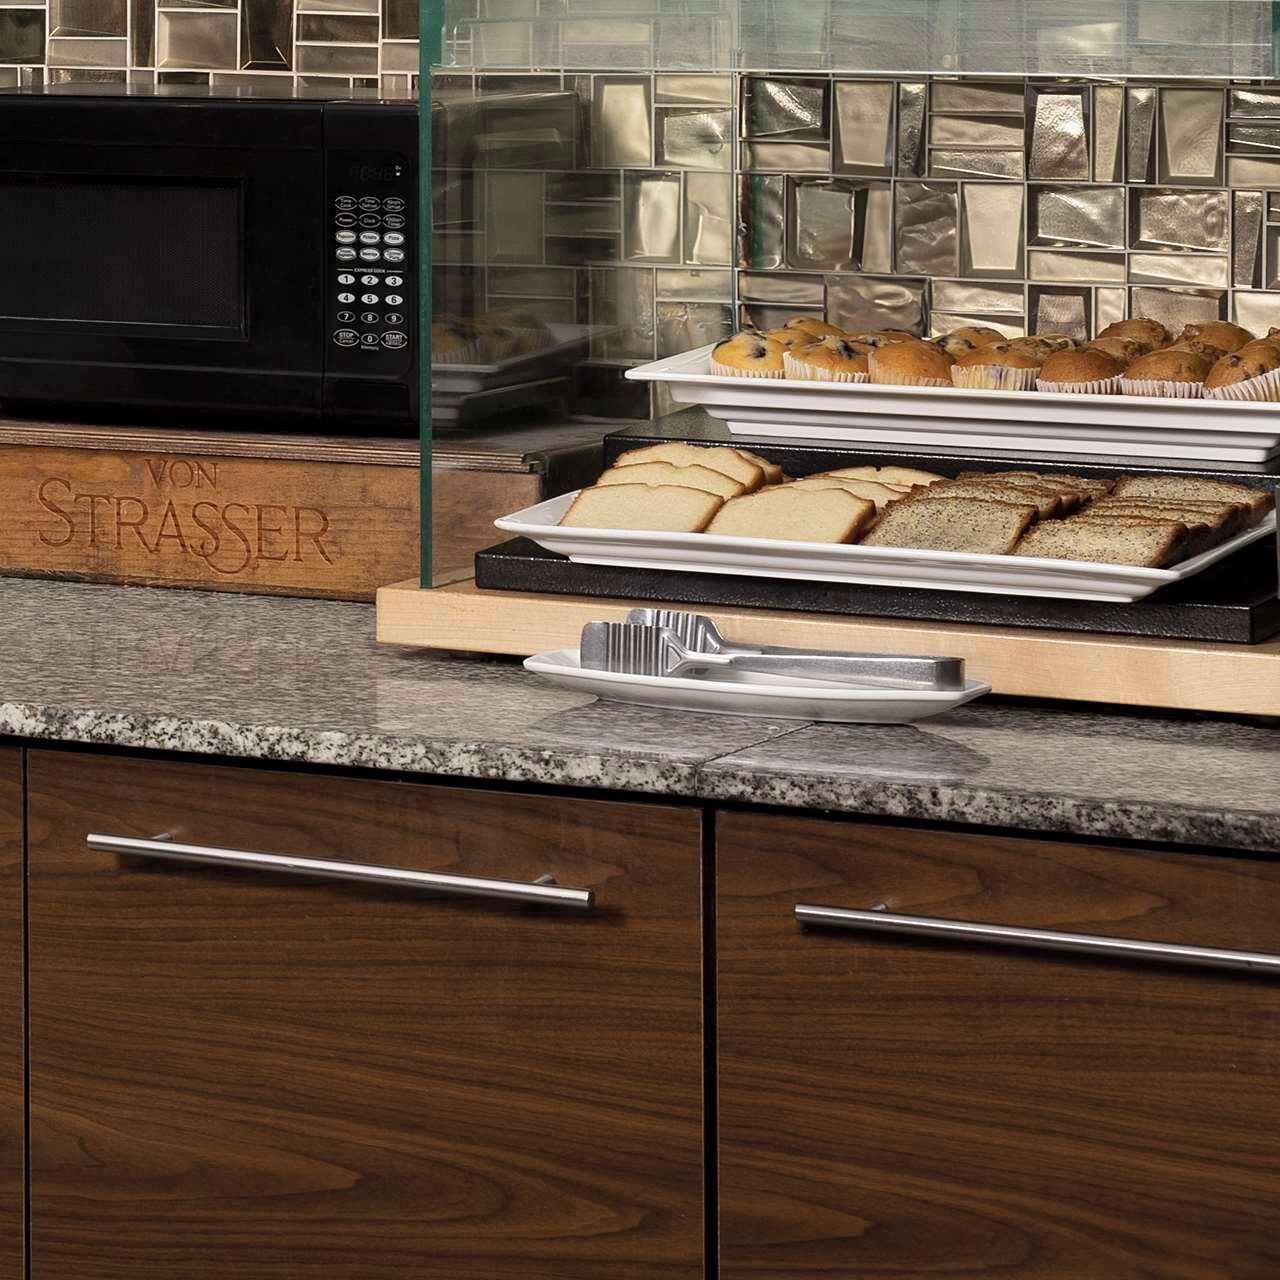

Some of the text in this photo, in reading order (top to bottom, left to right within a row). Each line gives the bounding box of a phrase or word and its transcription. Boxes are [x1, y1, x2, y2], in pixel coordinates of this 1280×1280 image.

[344, 275, 397, 285] 1 2 3
[367, 335, 373, 343] 0
[144, 459, 218, 489] VON
[38, 477, 334, 574] STRASSER
